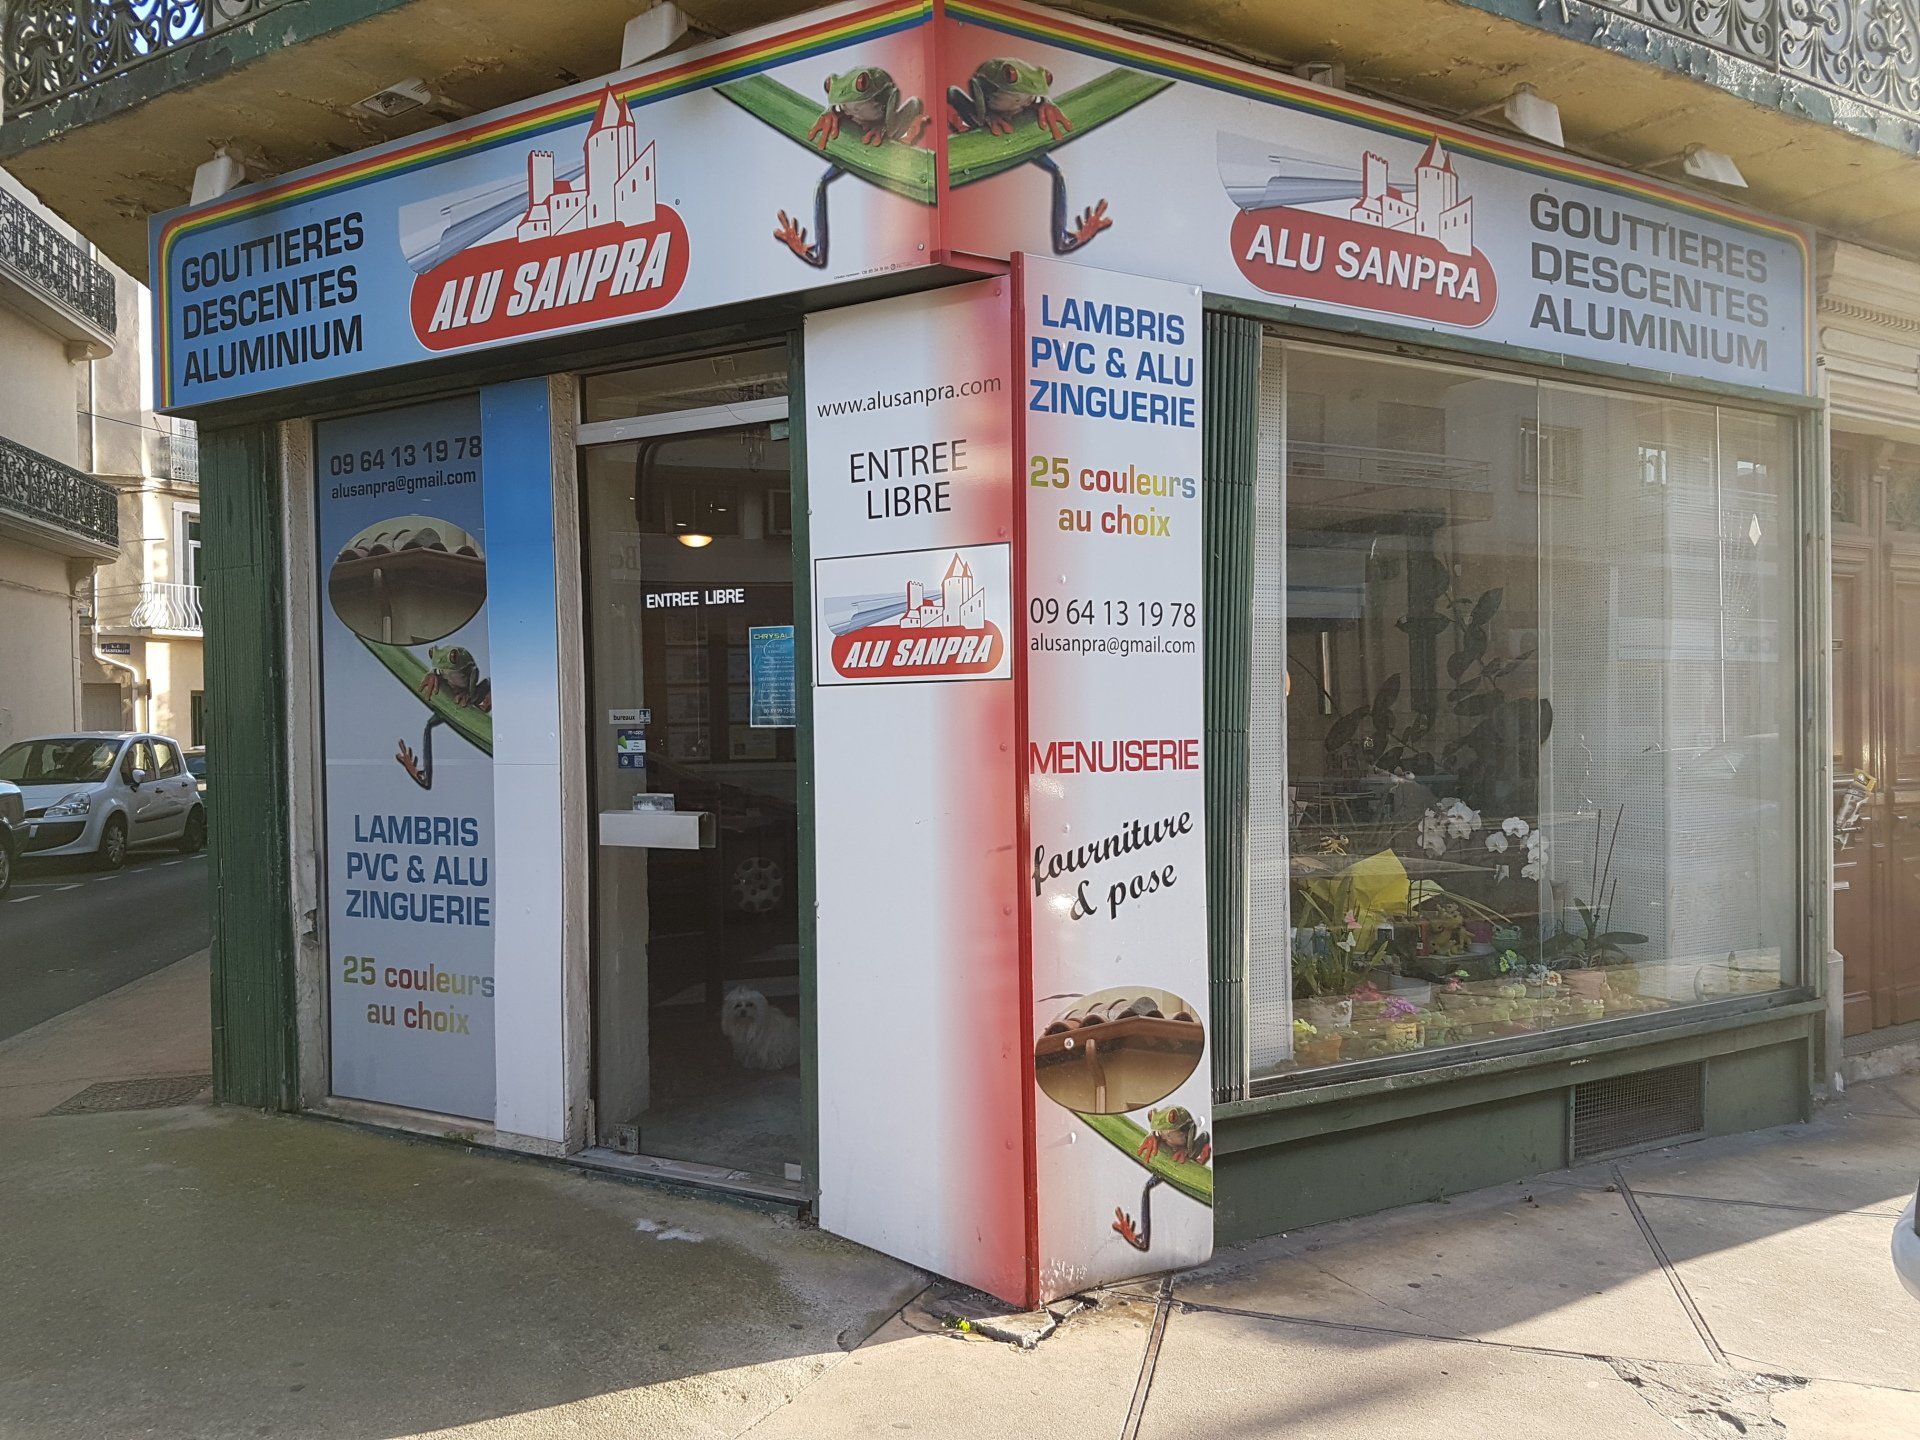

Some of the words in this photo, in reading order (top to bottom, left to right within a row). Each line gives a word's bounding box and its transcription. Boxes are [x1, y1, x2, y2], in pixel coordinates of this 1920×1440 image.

[181, 211, 364, 293] GOUTTIERES
[1530, 192, 1768, 284] GOUTTIERES
[428, 268, 504, 333] ALU
[506, 231, 671, 313] SANPRA
[1246, 224, 1325, 273] ALU
[1334, 240, 1481, 303] SANPRA
[183, 265, 358, 340] DESCENTES
[1531, 242, 1769, 329] DESCENTES
[1042, 294, 1185, 346] LAMBRIS
[1530, 293, 1769, 372] ALUMINIUM
[183, 314, 363, 387] ALUMINIUM
[1032, 336, 1096, 375] PVC
[1105, 347, 1127, 379] &
[1135, 351, 1194, 387] ALU
[817, 377, 1001, 417] www.alusanpra.com
[1029, 379, 1196, 428] ZINGUERIE
[330, 454, 354, 476] 09
[360, 449, 385, 472] 64
[391, 444, 416, 468] 13
[423, 440, 448, 463] 19
[454, 435, 482, 460] 78
[850, 438, 968, 484] ENTREE
[1030, 455, 1070, 490] 25
[1079, 464, 1196, 499] couleurs
[332, 470, 476, 500] alusanpra@gmail.com
[868, 481, 951, 520] LIBRE
[1058, 508, 1091, 532] au
[1101, 504, 1171, 537] choix
[646, 591, 700, 609] ENTREE
[705, 588, 745, 605] LIBRE
[1030, 597, 1060, 624] 09
[1066, 599, 1095, 625] 64
[1104, 600, 1129, 626] 13
[1138, 601, 1164, 627] 19
[1170, 602, 1196, 628] 78
[842, 640, 891, 669] ALU
[892, 634, 994, 667] SANPRA
[1030, 632, 1196, 657] alusanpra@gmail.com
[613, 713, 636, 721] bureaux
[1030, 739, 1199, 774] MENUISERIE
[354, 814, 479, 847] LAMBRIS
[347, 852, 398, 882] PVC
[407, 855, 426, 884] &
[433, 856, 488, 887] ALU
[1032, 811, 1194, 897] fourniture
[346, 889, 490, 927] ZINGUERIE
[1107, 864, 1178, 920] pose
[343, 955, 376, 986] 25
[384, 963, 495, 998] couleurs
[367, 1003, 396, 1026] au
[404, 1001, 471, 1035] choix
